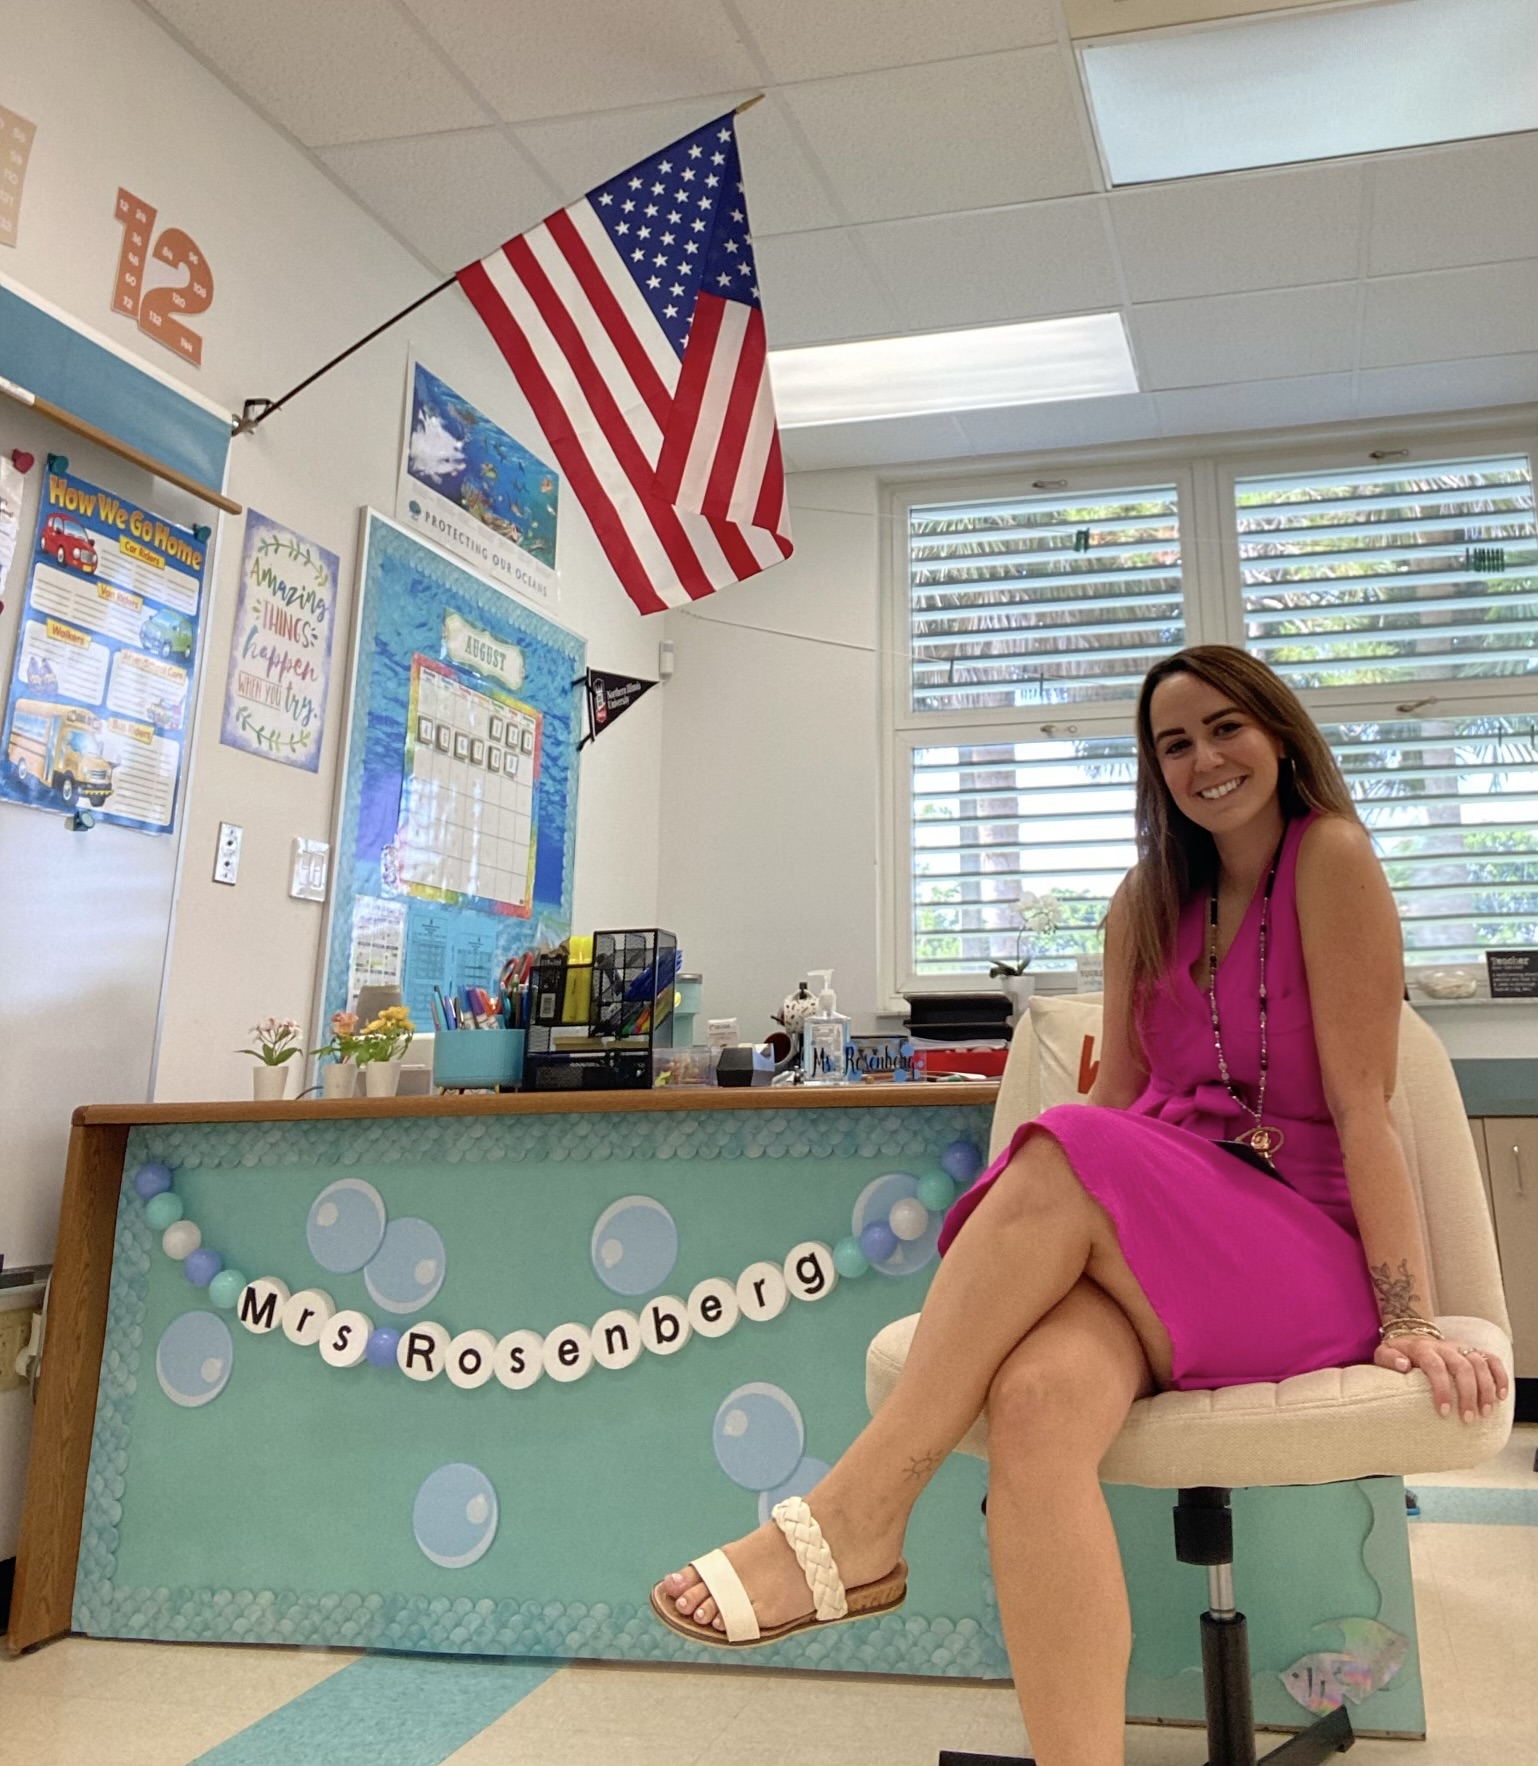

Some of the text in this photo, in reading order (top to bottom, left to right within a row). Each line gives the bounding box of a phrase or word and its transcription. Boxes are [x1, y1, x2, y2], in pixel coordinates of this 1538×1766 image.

[111, 186, 214, 369] 12
[50, 476, 96, 518] How
[98, 493, 129, 530] We
[130, 510, 153, 543] Go
[154, 522, 203, 571] Home
[124, 541, 161, 566] Car Riders
[425, 511, 548, 597] PROTECTING OUR OCEANS
[100, 583, 115, 599] Van
[250, 556, 329, 623] Amazing
[51, 625, 86, 646] Walkers
[262, 599, 311, 649] THINGS
[243, 624, 319, 684] happen
[464, 634, 507, 672] AUGUST
[238, 673, 262, 699] WHEN
[264, 681, 282, 707] YOU
[240, 1251, 824, 1375] Mrs Rosenberg
